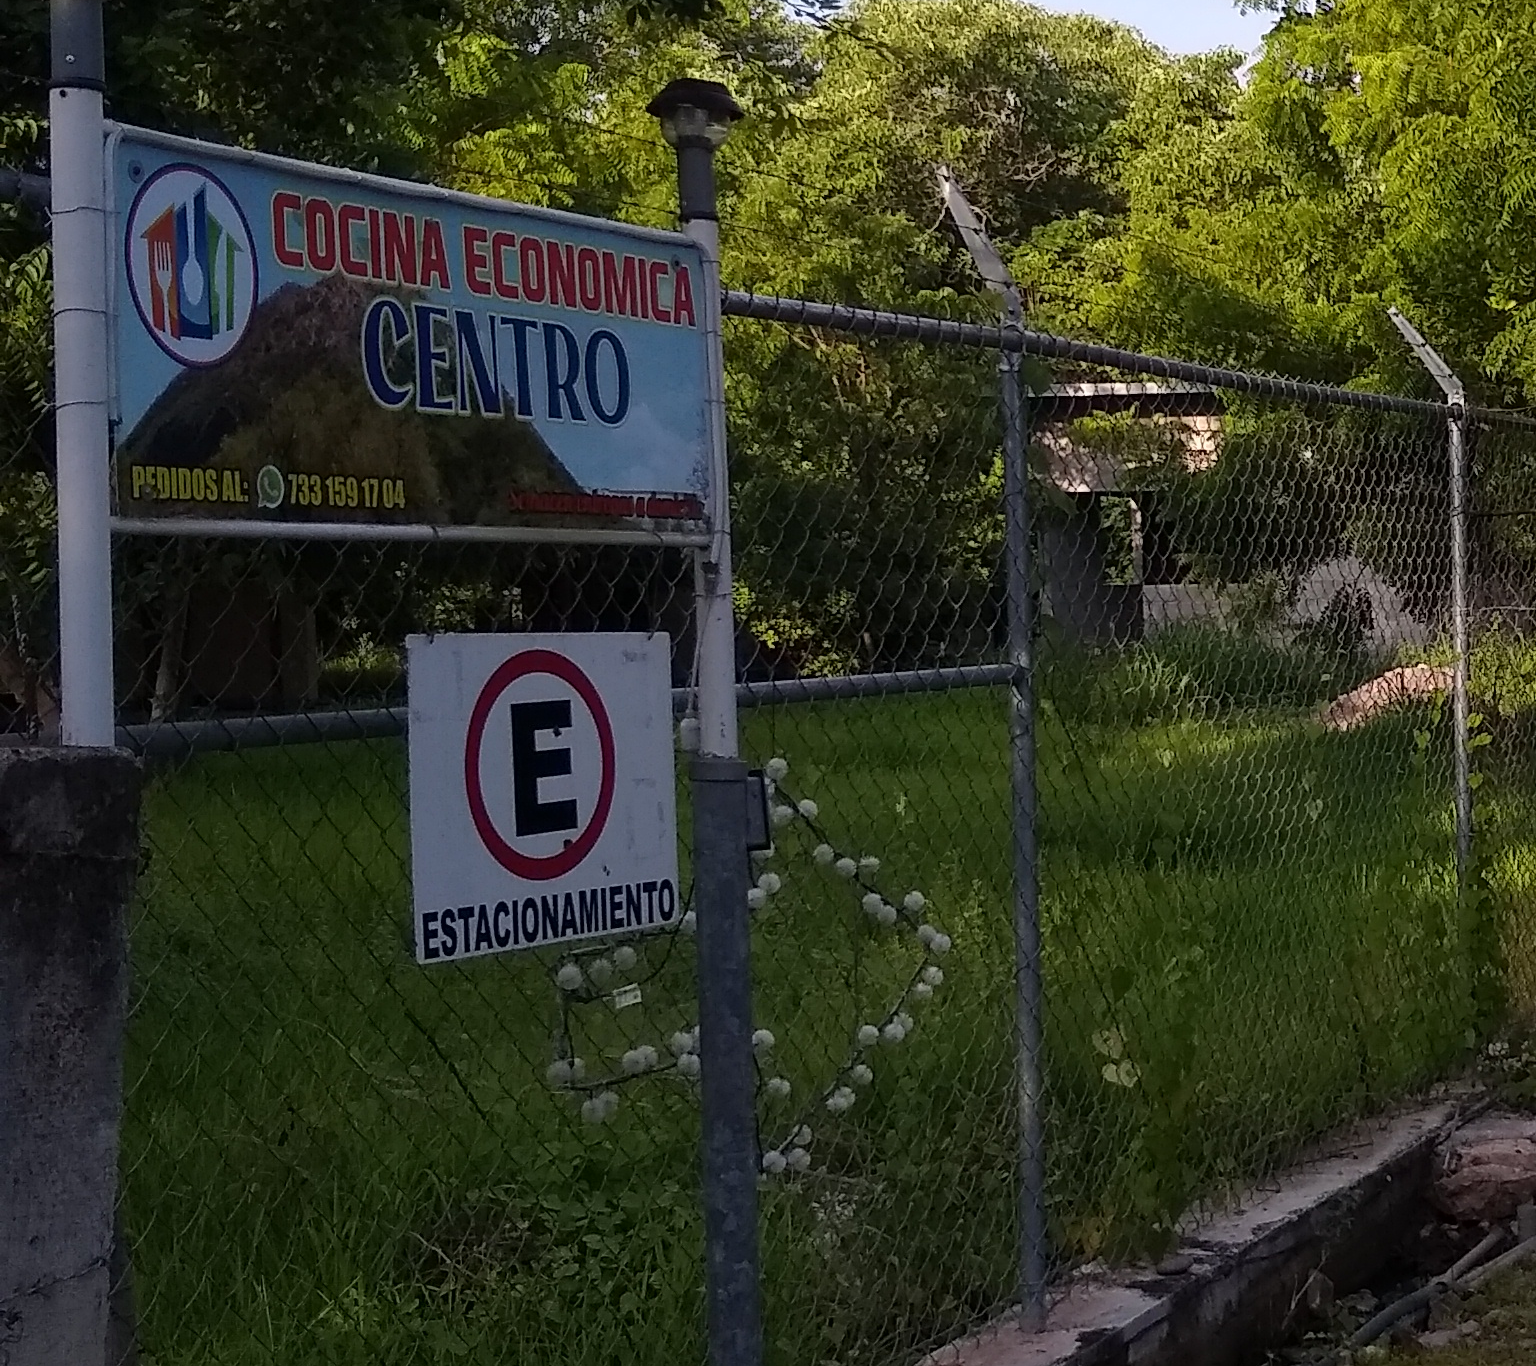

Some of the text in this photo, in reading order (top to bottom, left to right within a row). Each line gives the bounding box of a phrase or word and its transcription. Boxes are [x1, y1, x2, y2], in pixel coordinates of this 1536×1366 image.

[271, 190, 696, 328] COCINA ECONOMICA
[362, 295, 631, 427] CENTRO
[131, 465, 406, 509] PEDIDOS AL: 733 159 17 04
[510, 699, 578, 837] E
[422, 878, 675, 960] ESTACIONAMIENTO
